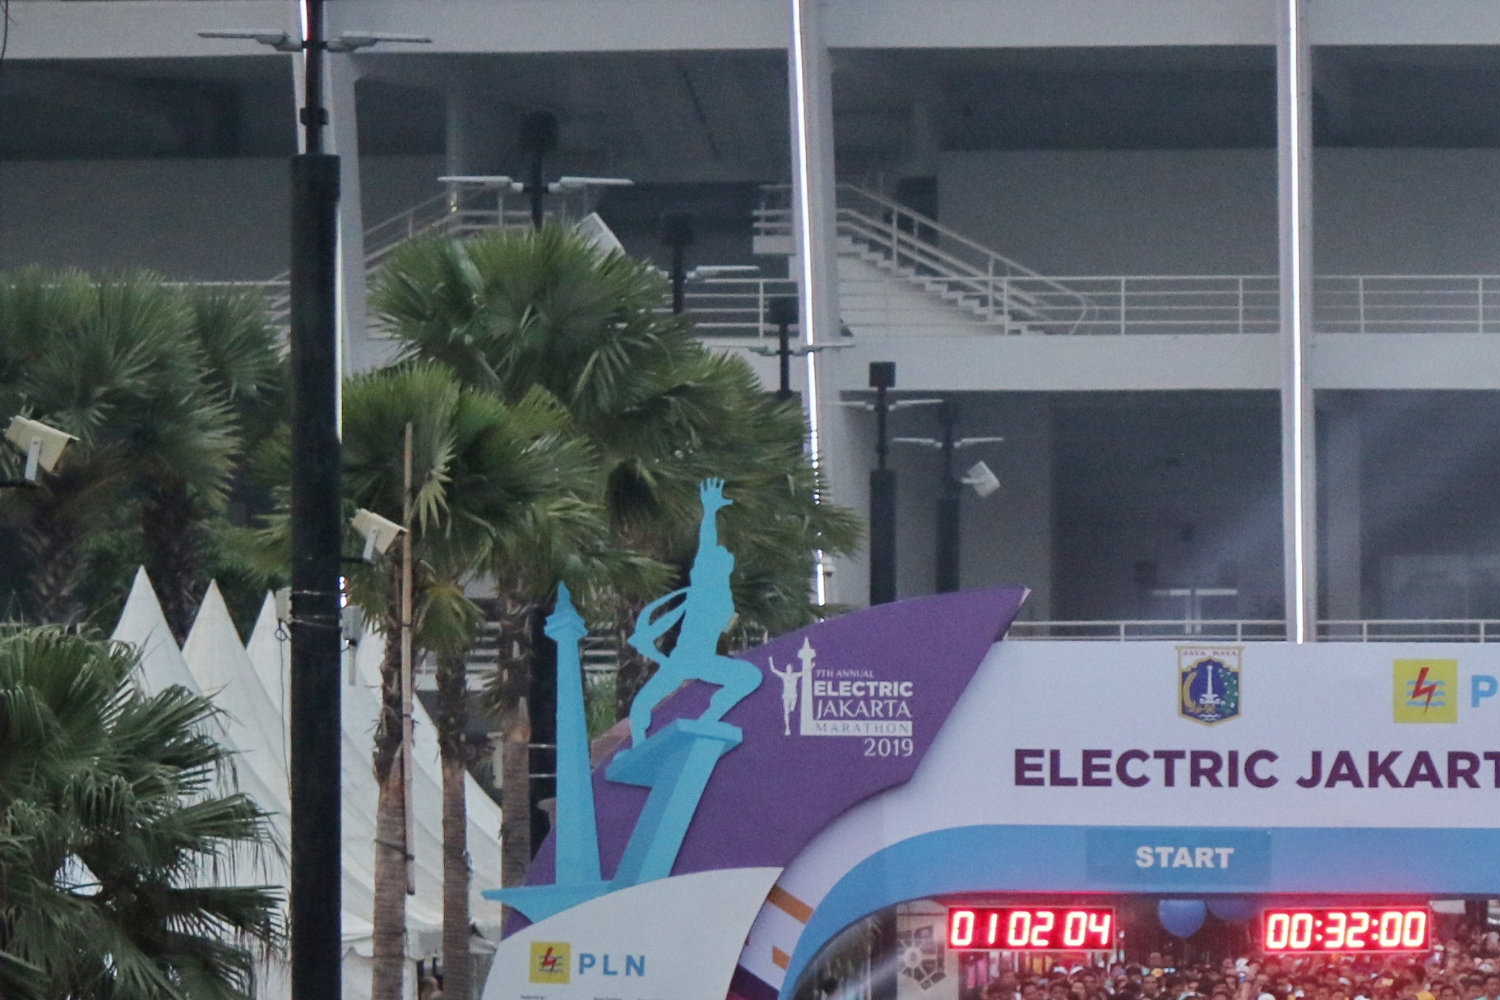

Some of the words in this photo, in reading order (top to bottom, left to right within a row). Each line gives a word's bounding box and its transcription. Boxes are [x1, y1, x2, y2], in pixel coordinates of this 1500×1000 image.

[815, 669, 834, 678] 7TH
[836, 669, 874, 678] ANNUAL
[813, 680, 914, 697] ELECTRIC
[815, 699, 913, 720] JAKARTA
[815, 722, 909, 734] MARATHON
[863, 738, 914, 757] 2019
[1014, 749, 1279, 787] ELECTRIC
[1135, 846, 1235, 869] START
[1266, 911, 1427, 949] 00:32:00
[578, 952, 646, 977] PLN
